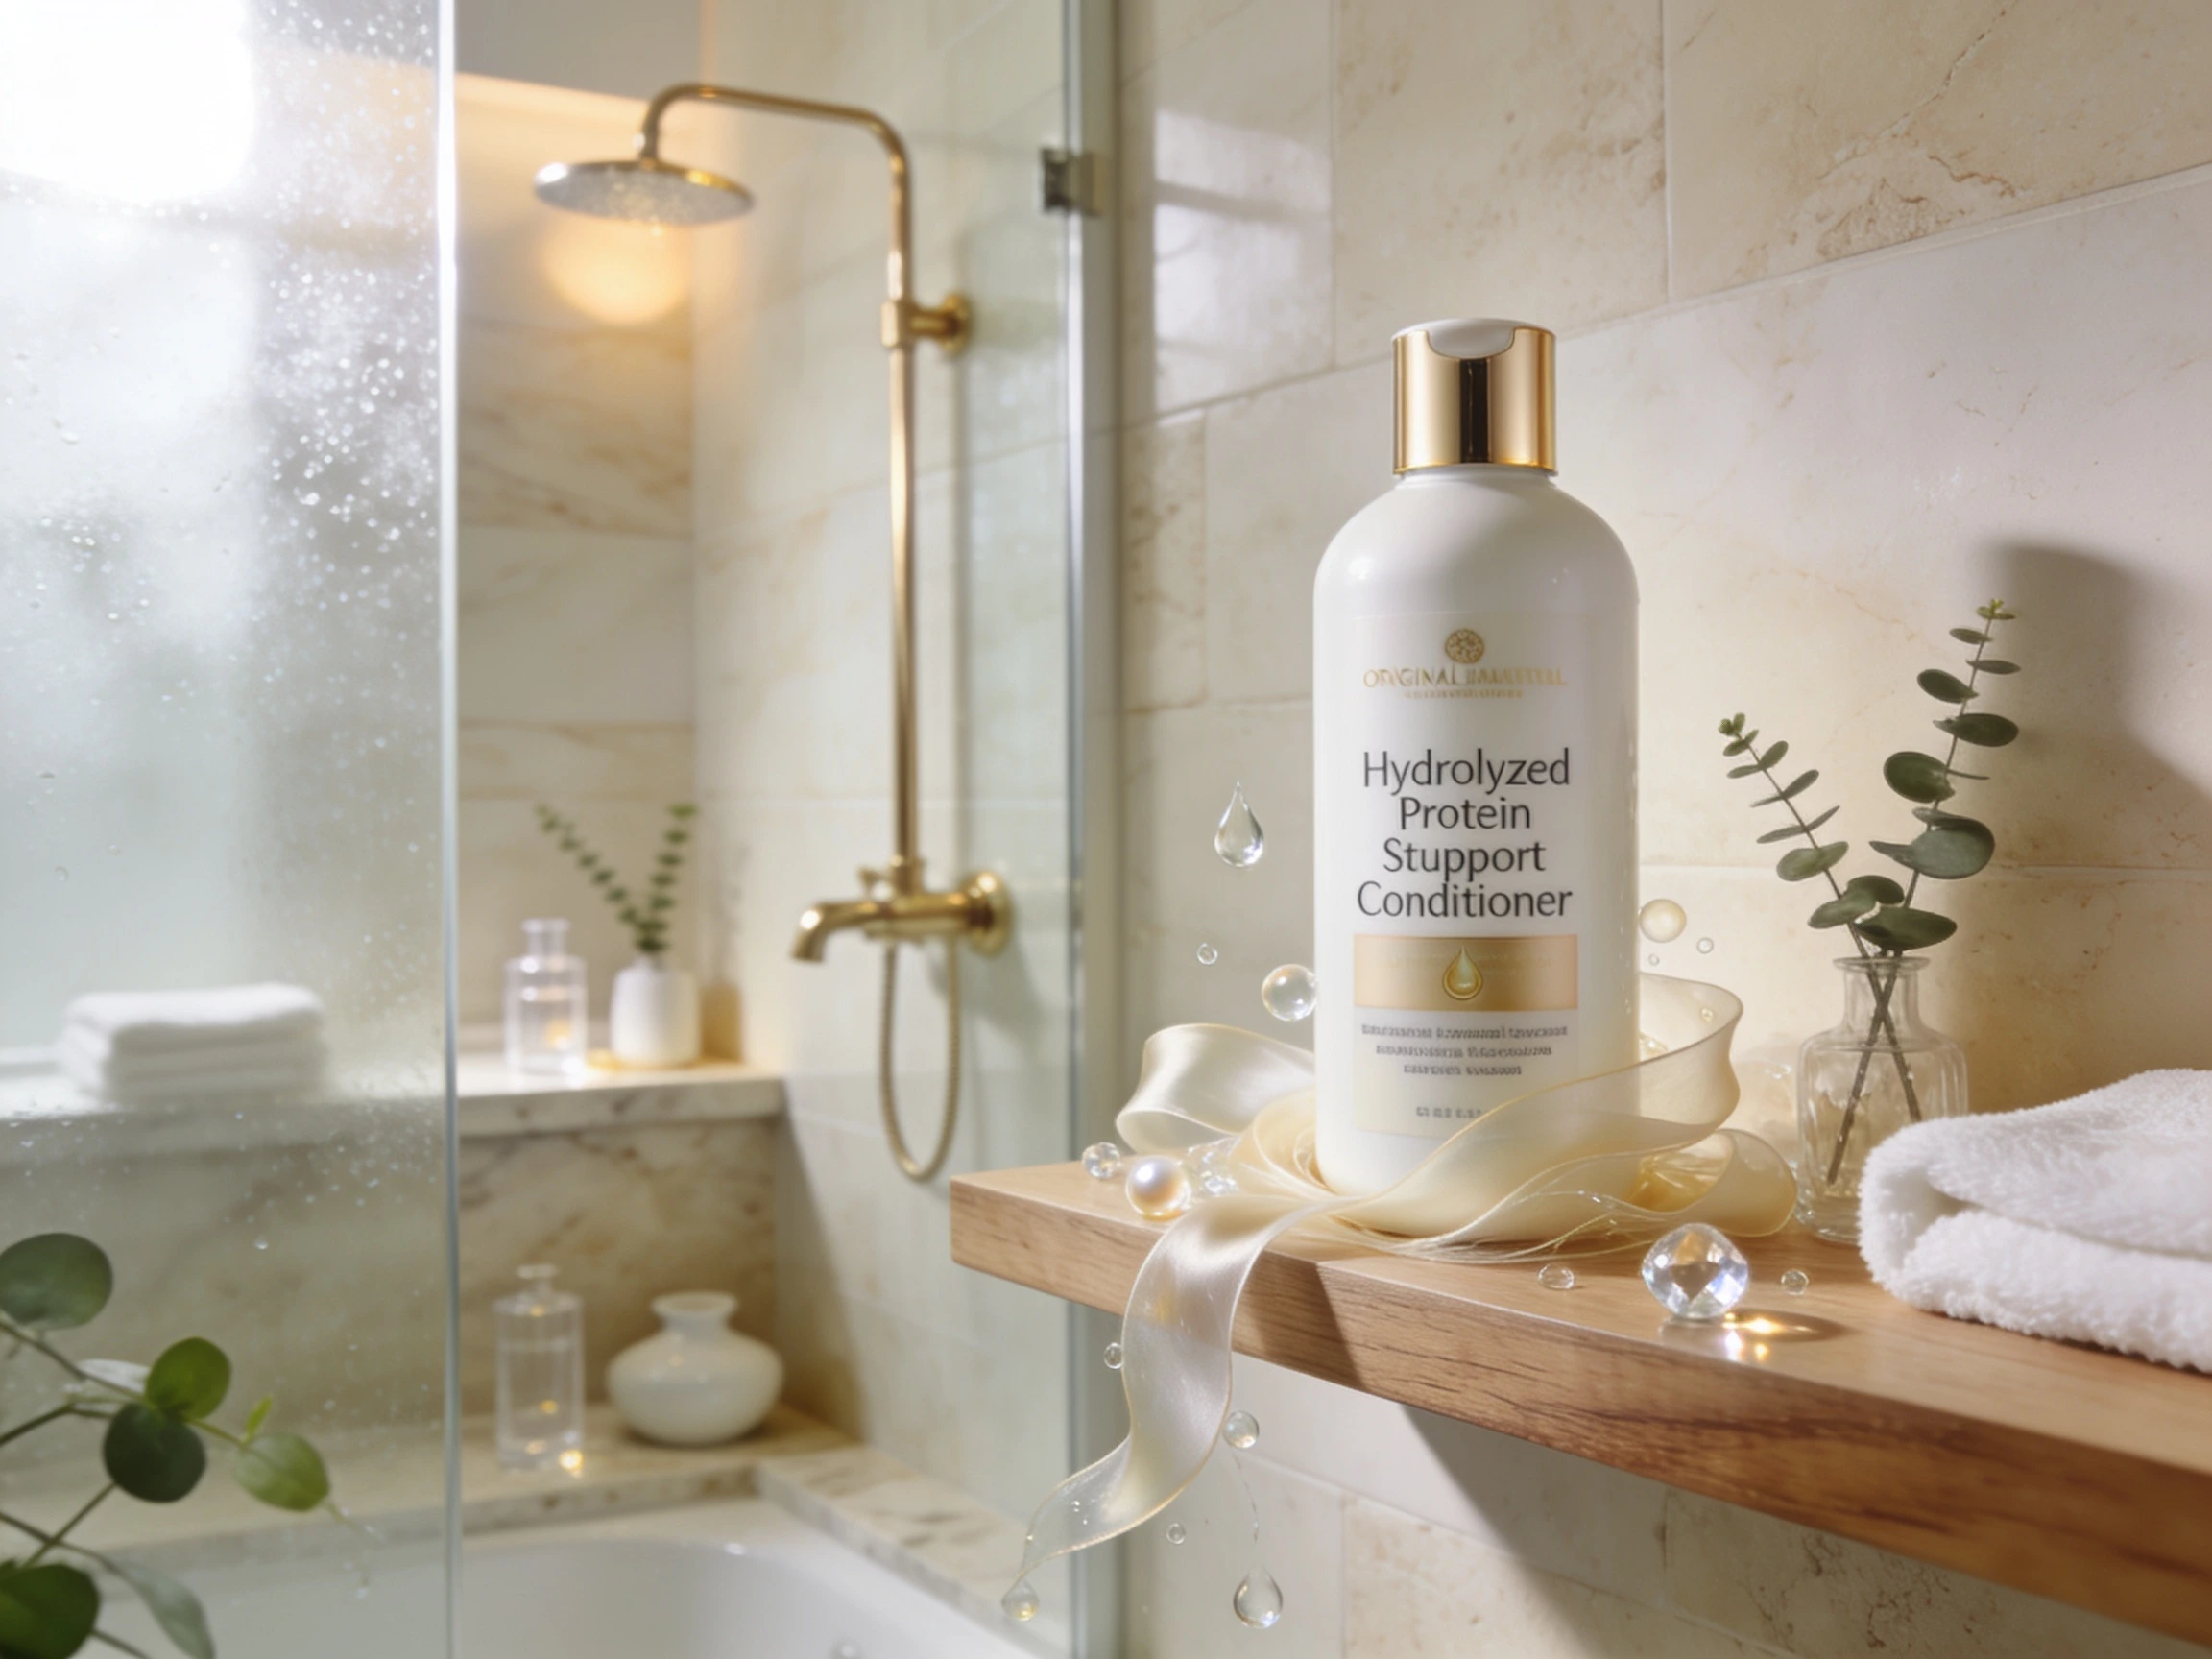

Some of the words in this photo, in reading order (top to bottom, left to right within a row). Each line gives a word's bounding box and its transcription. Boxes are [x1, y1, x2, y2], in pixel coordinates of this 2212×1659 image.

[1363, 747, 1571, 796] Hydrolyzed
[1400, 796, 1532, 830] Protein
[1382, 837, 1548, 882] Stupport
[1357, 880, 1574, 918] Conditioner
